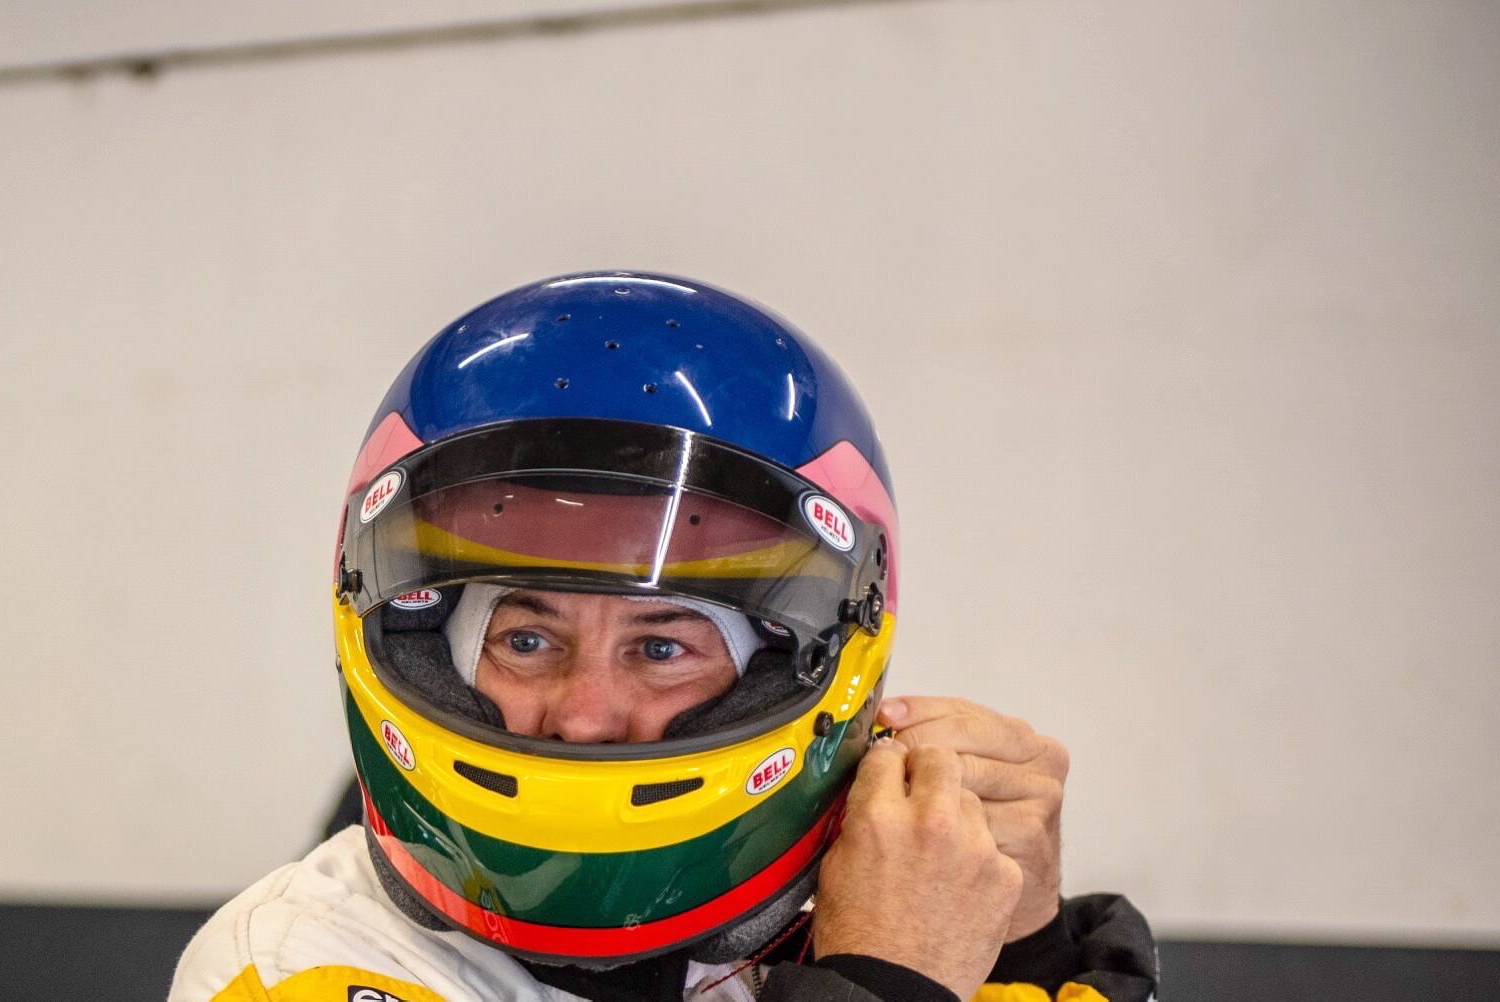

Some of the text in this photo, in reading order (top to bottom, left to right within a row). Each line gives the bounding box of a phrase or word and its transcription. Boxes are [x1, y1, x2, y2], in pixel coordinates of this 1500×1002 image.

[365, 480, 393, 513] BELL
[814, 502, 847, 541] BELL
[385, 724, 409, 765] BELL
[753, 755, 789, 789] BELL
